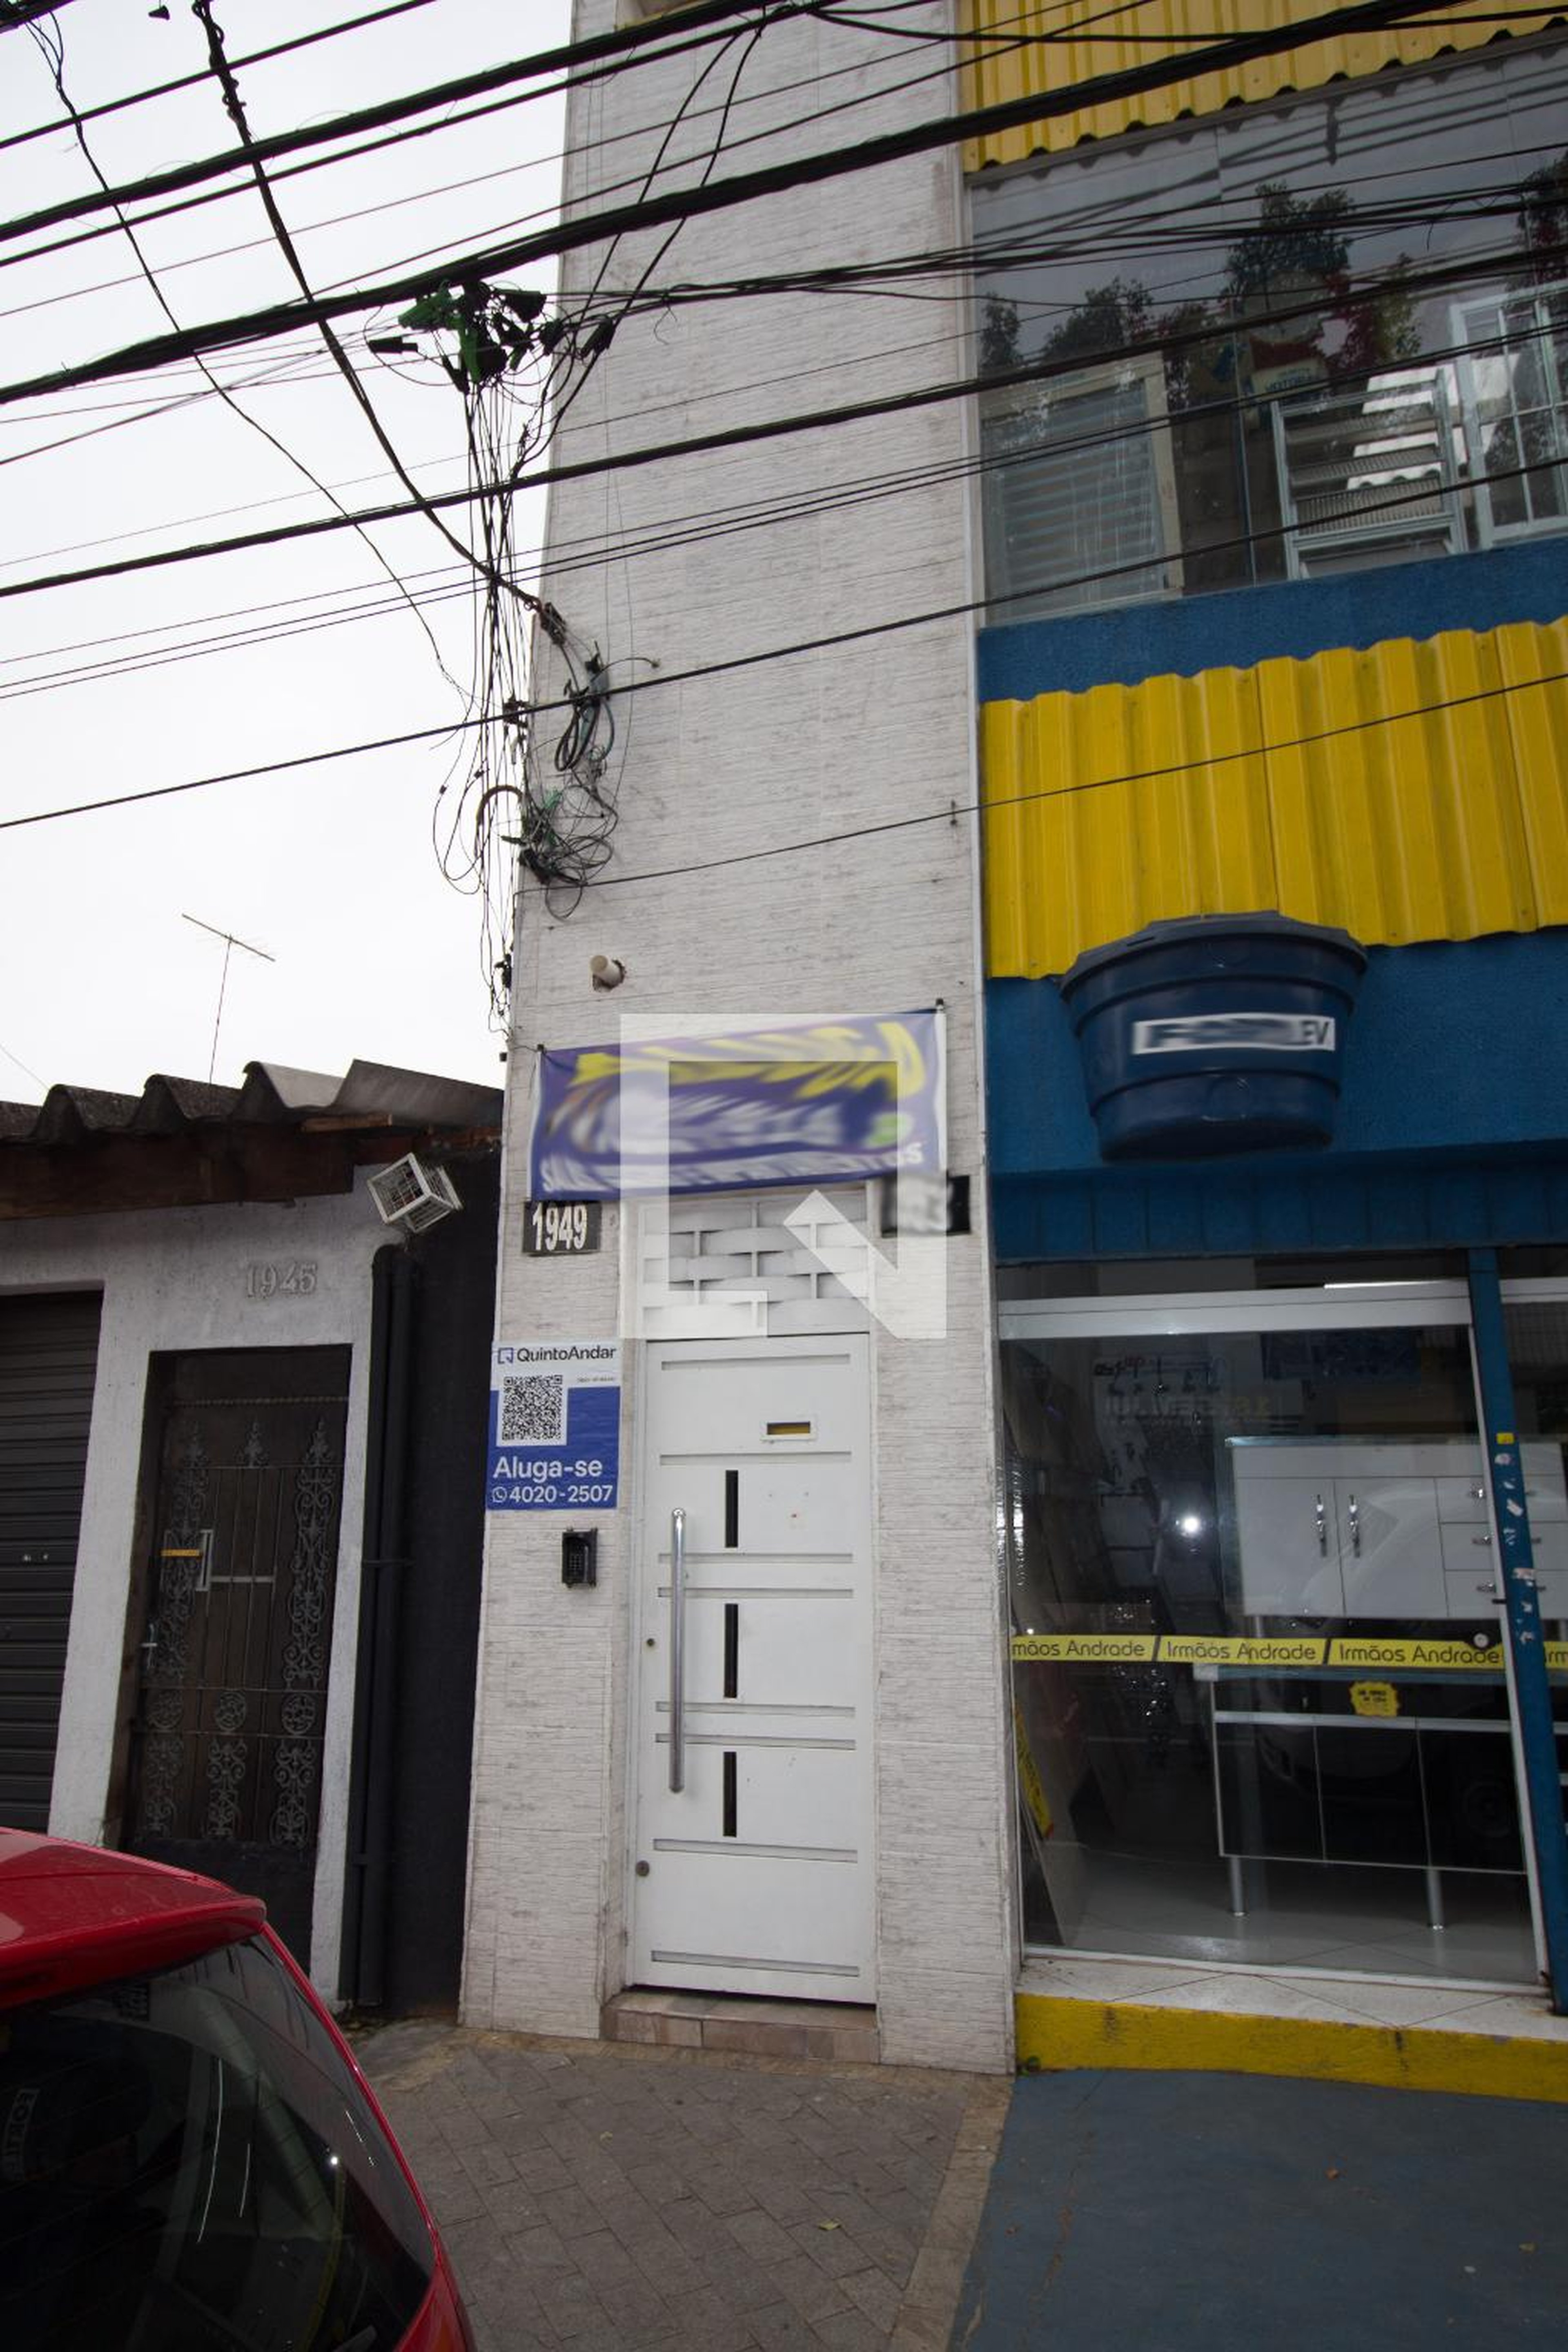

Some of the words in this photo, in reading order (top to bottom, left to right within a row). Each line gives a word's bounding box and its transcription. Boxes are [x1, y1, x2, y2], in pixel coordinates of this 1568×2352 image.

[532, 1202, 587, 1251] 1949
[246, 1262, 318, 1297] 1945
[517, 1345, 616, 1362] QuintoAndar
[493, 1456, 603, 1483] Aluga-se
[1065, 1640, 1146, 1657] Andrade
[1168, 1642, 1229, 1659] Irmãos
[1237, 1642, 1316, 1660] Andrade
[1340, 1642, 1406, 1662] Irmãos
[1412, 1646, 1500, 1664] Andrade
